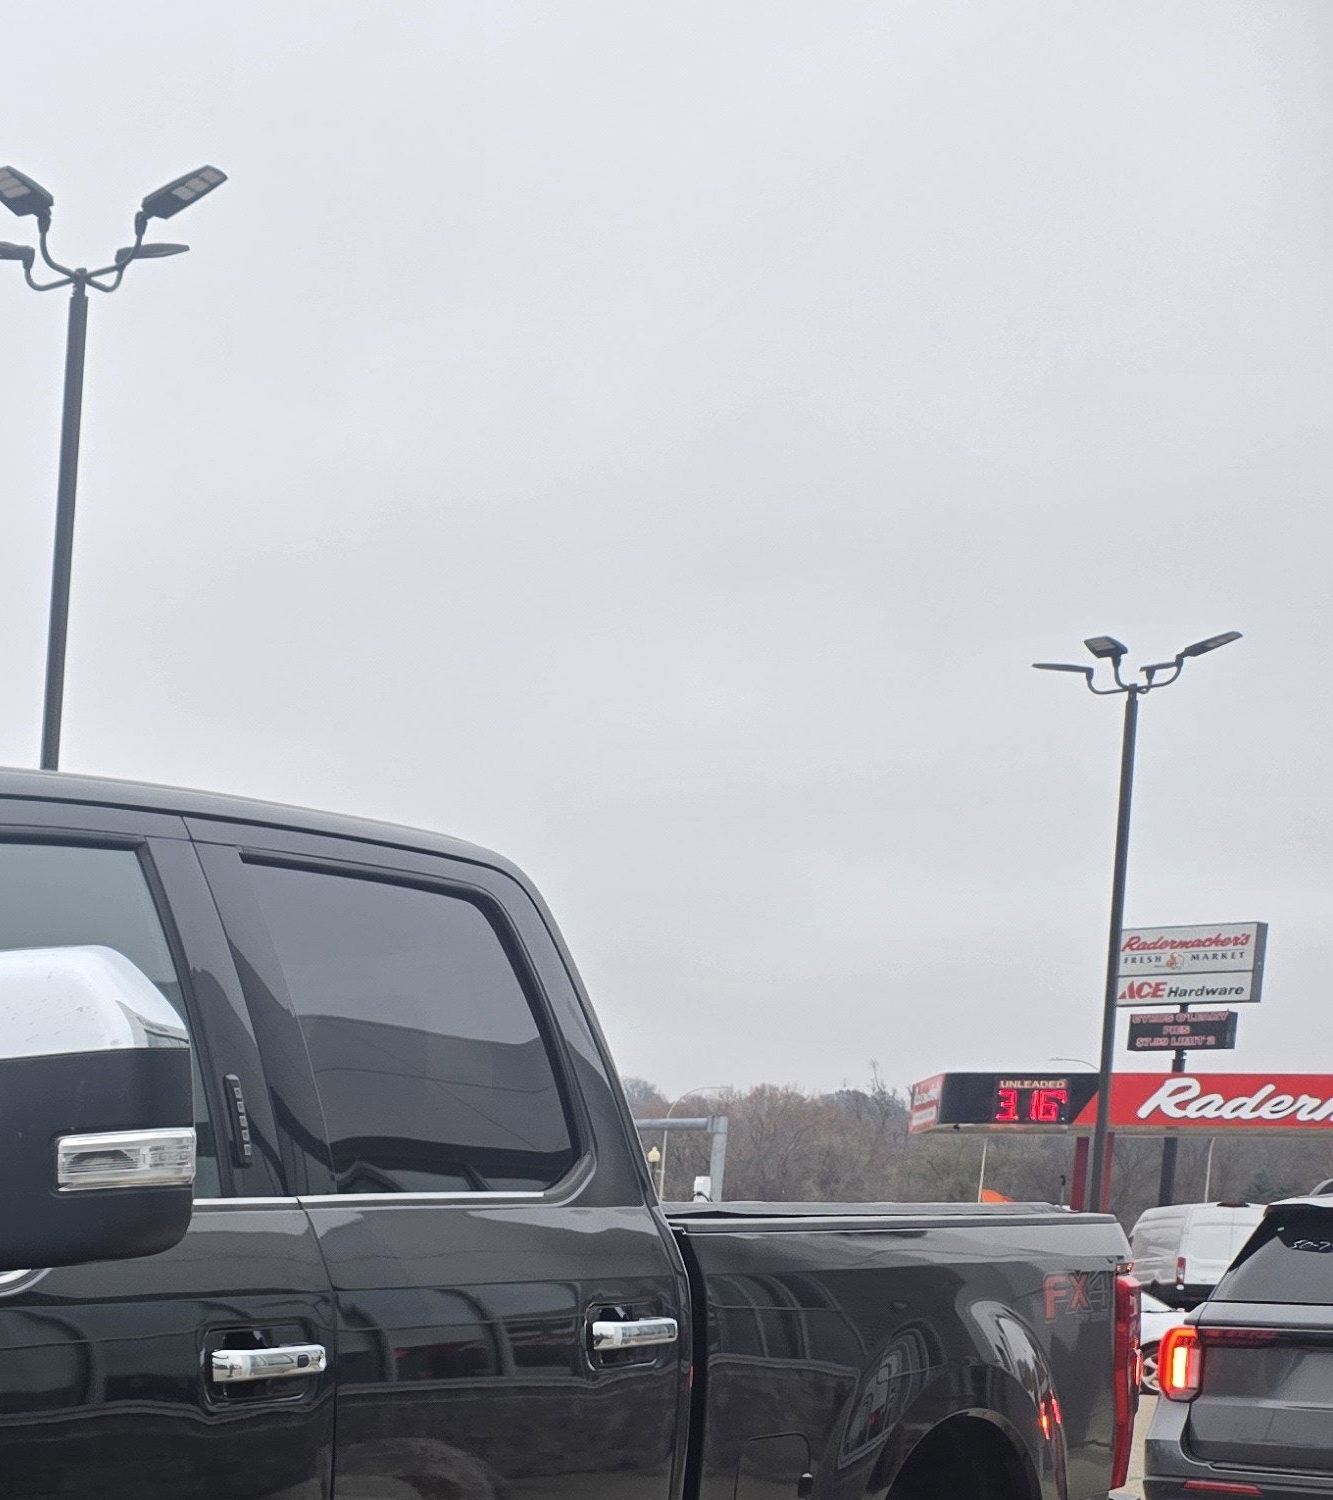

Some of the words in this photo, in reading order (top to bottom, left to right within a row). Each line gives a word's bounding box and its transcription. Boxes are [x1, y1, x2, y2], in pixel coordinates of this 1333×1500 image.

[1121, 933, 1251, 952] Radermacher's
[1124, 955, 1162, 964] FRESH
[1190, 952, 1245, 961] MARKET
[1118, 981, 1168, 999] ACE
[1167, 985, 1245, 998] Hardware
[999, 1079, 1066, 1089] UNLEADED
[1136, 1077, 1333, 1122] Rader
[1043, 1270, 1110, 1324] FX4
